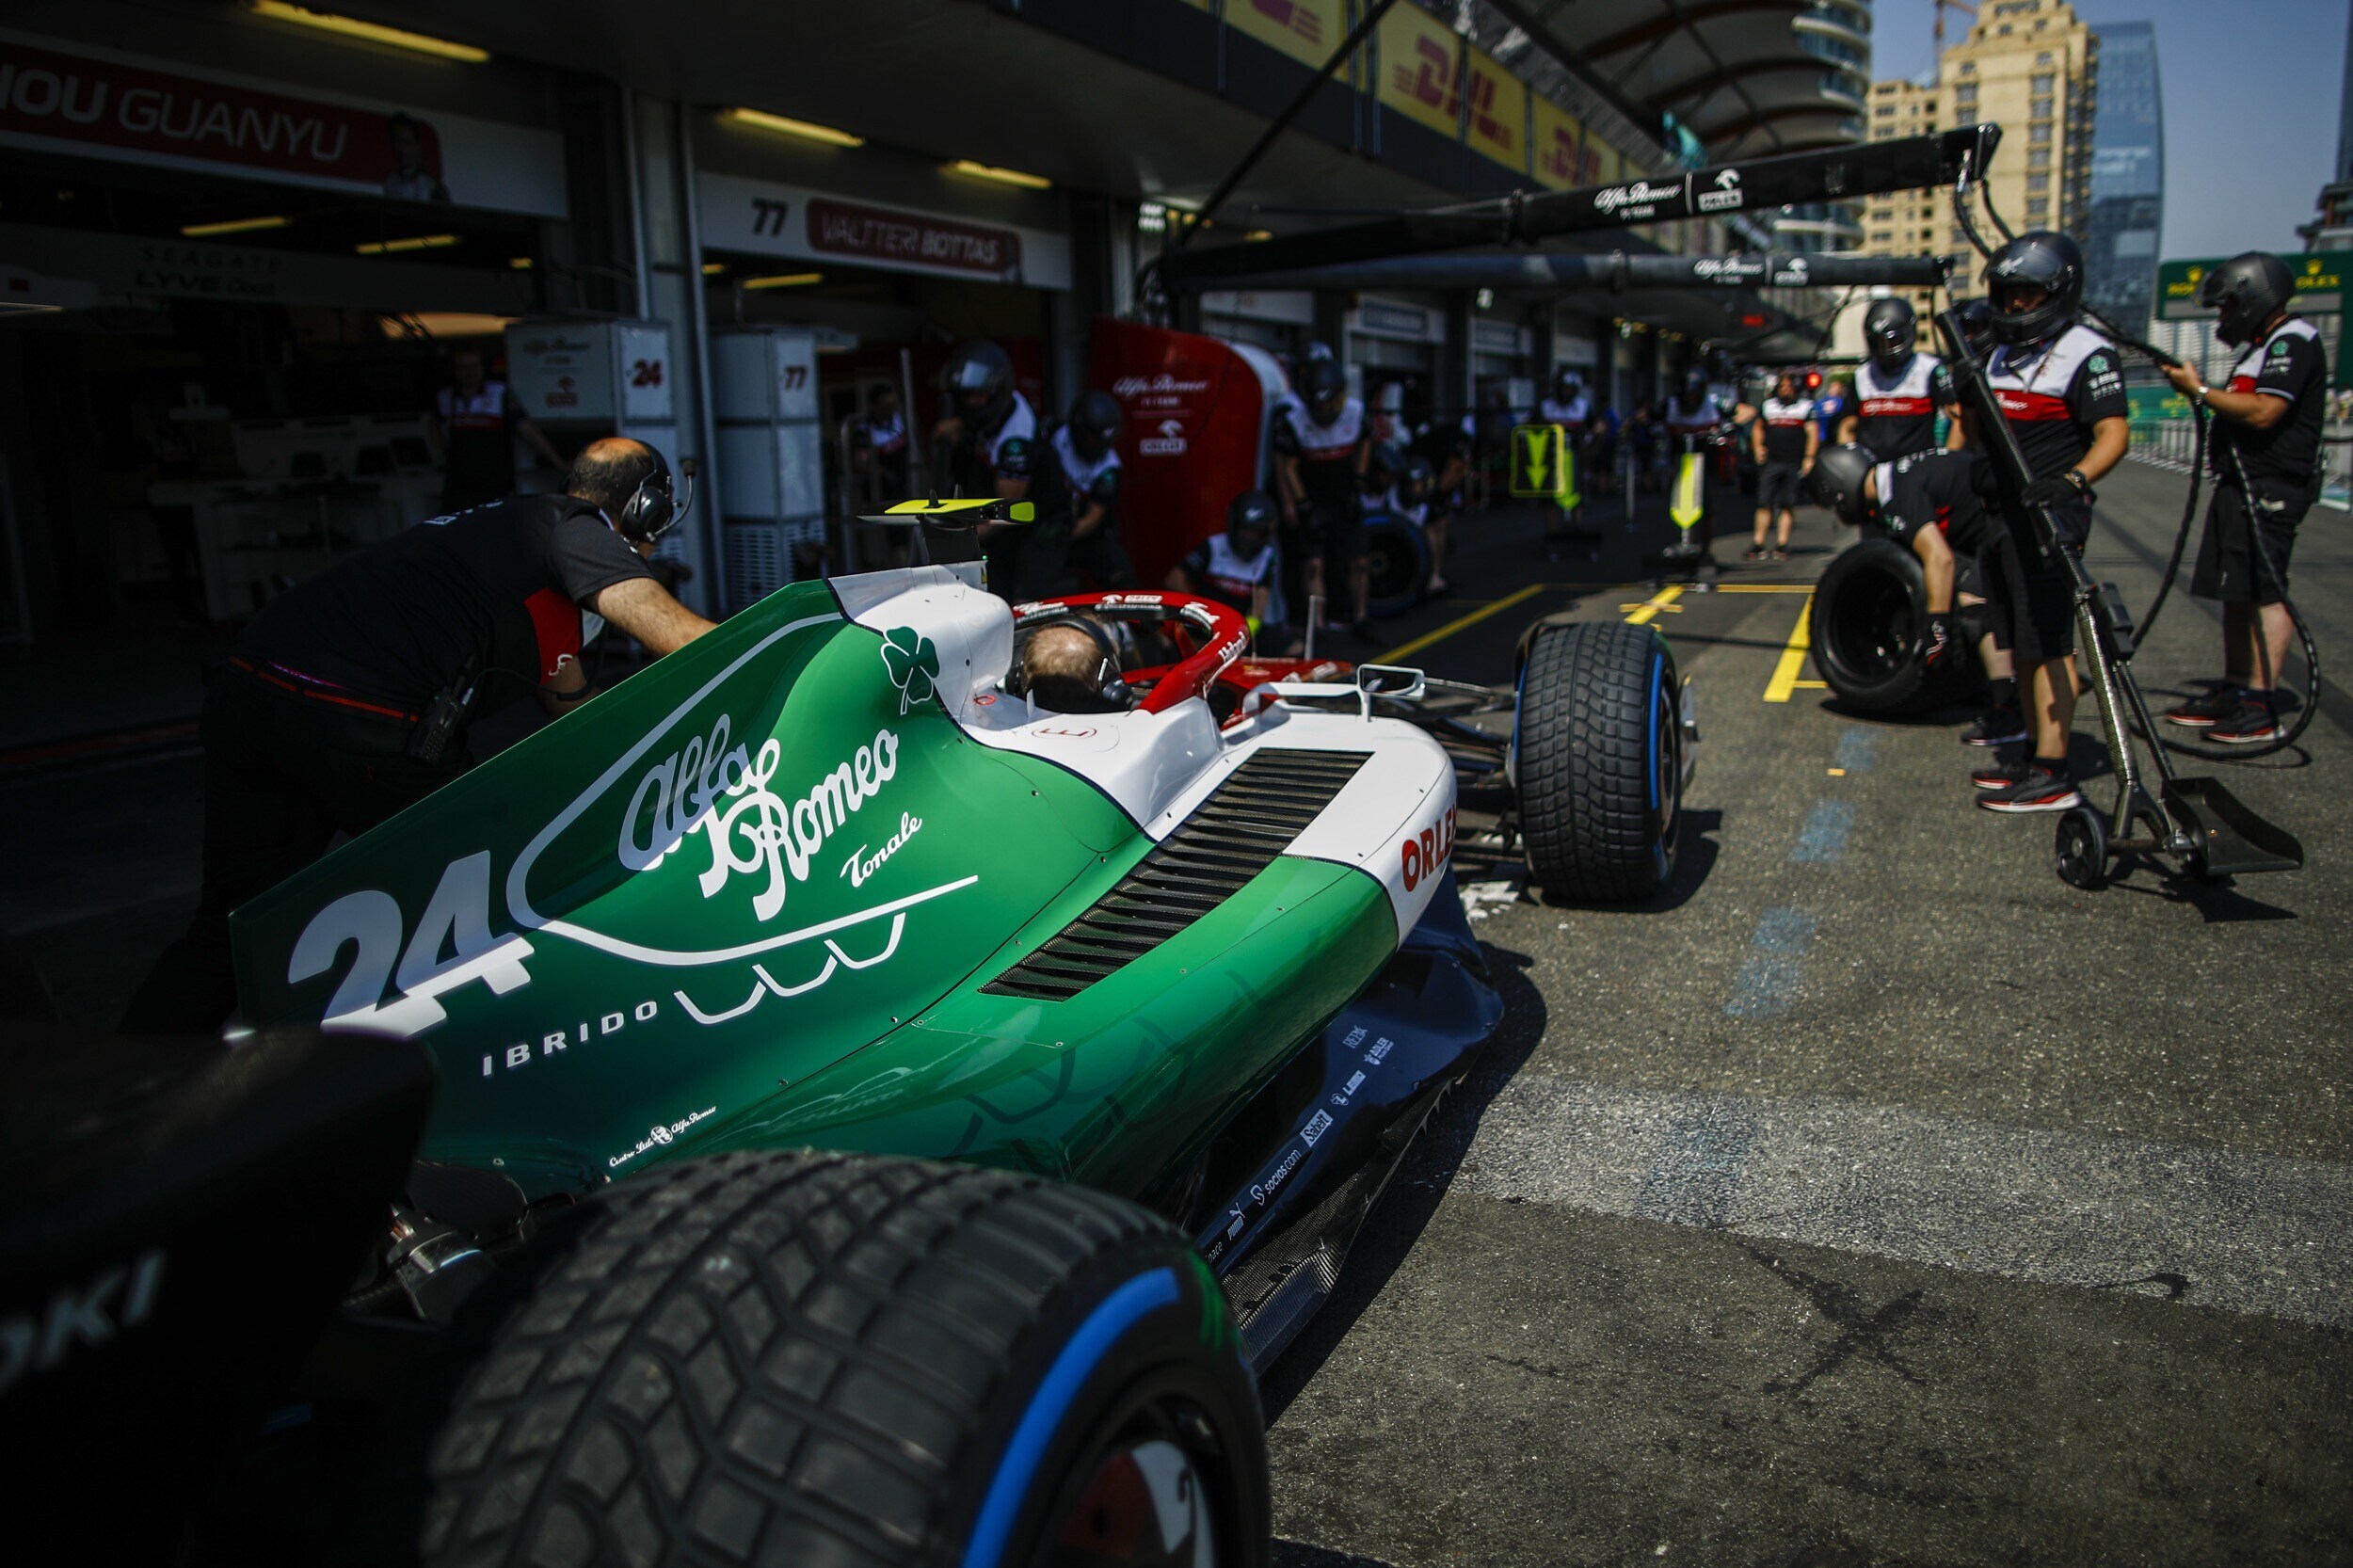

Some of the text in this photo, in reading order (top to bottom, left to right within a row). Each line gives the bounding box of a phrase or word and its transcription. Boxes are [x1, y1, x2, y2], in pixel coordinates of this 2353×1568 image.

[119, 88, 349, 162] GUANYU
[752, 198, 788, 236] 77
[142, 244, 282, 276] SEAGATE
[921, 232, 1000, 265] BOTTAS
[632, 359, 662, 388] 24
[784, 365, 807, 390] 77
[618, 713, 899, 921] Alfa Romeo
[840, 811, 922, 888] Tonale
[288, 850, 536, 1038] 24
[483, 1000, 657, 1077] IBRIDO
[1304, 1112, 1331, 1144] Sabelt
[1264, 1149, 1303, 1195] socios.com
